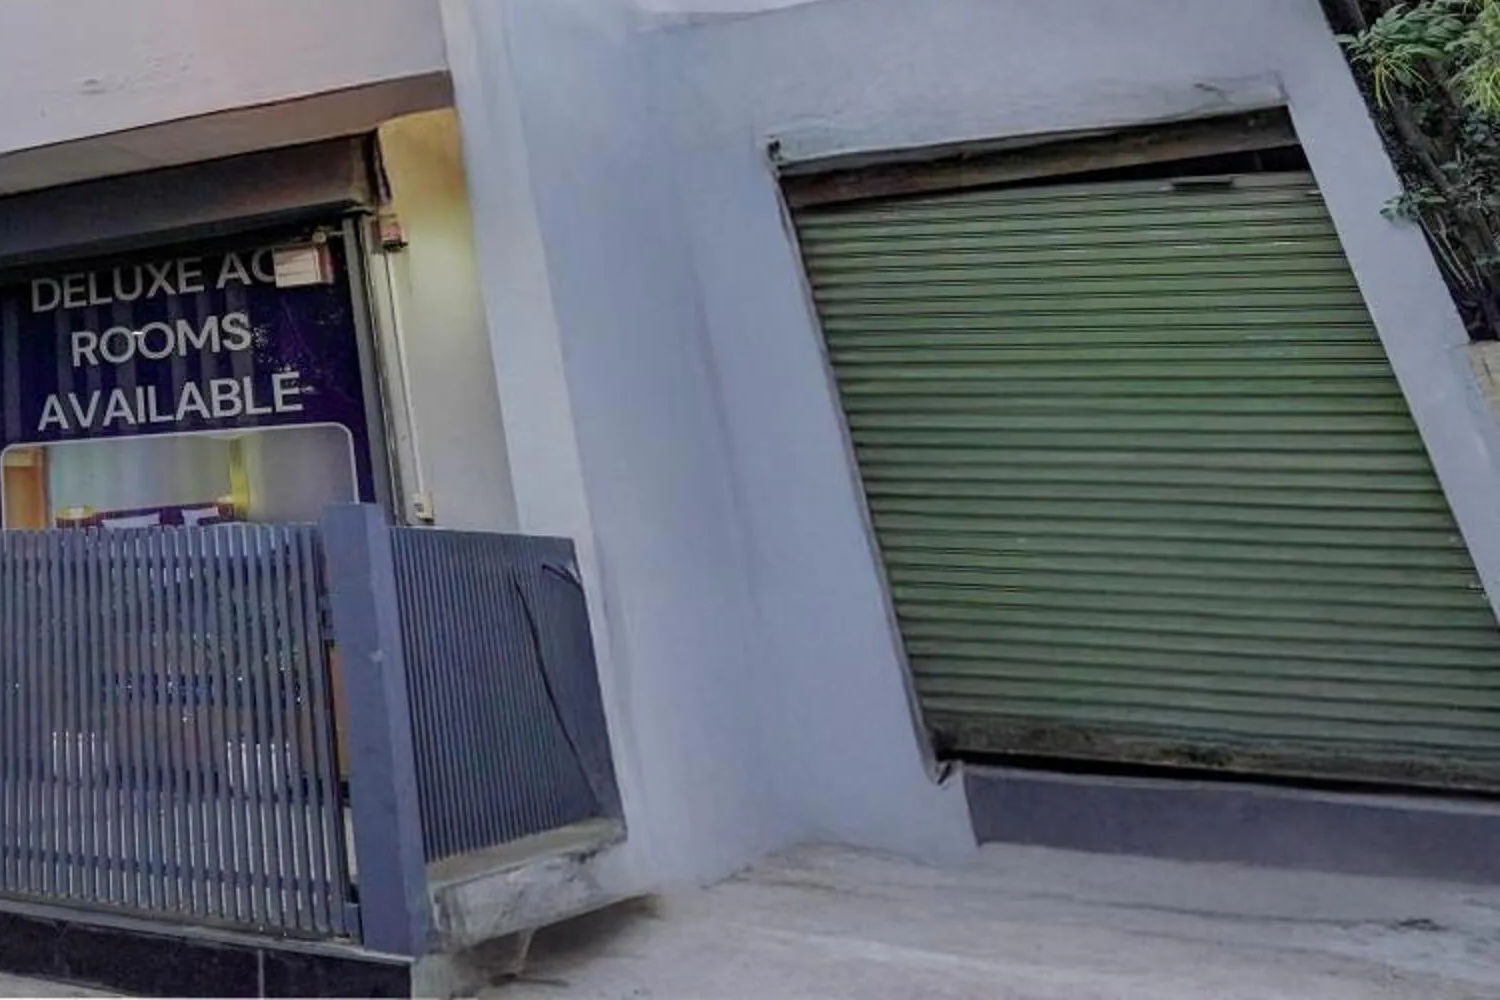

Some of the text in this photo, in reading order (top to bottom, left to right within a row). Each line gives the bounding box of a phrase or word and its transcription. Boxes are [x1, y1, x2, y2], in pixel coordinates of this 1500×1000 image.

[31, 257, 205, 313] DELUXE
[71, 312, 252, 367] ROOMS
[37, 370, 304, 431] AVAILABLE
